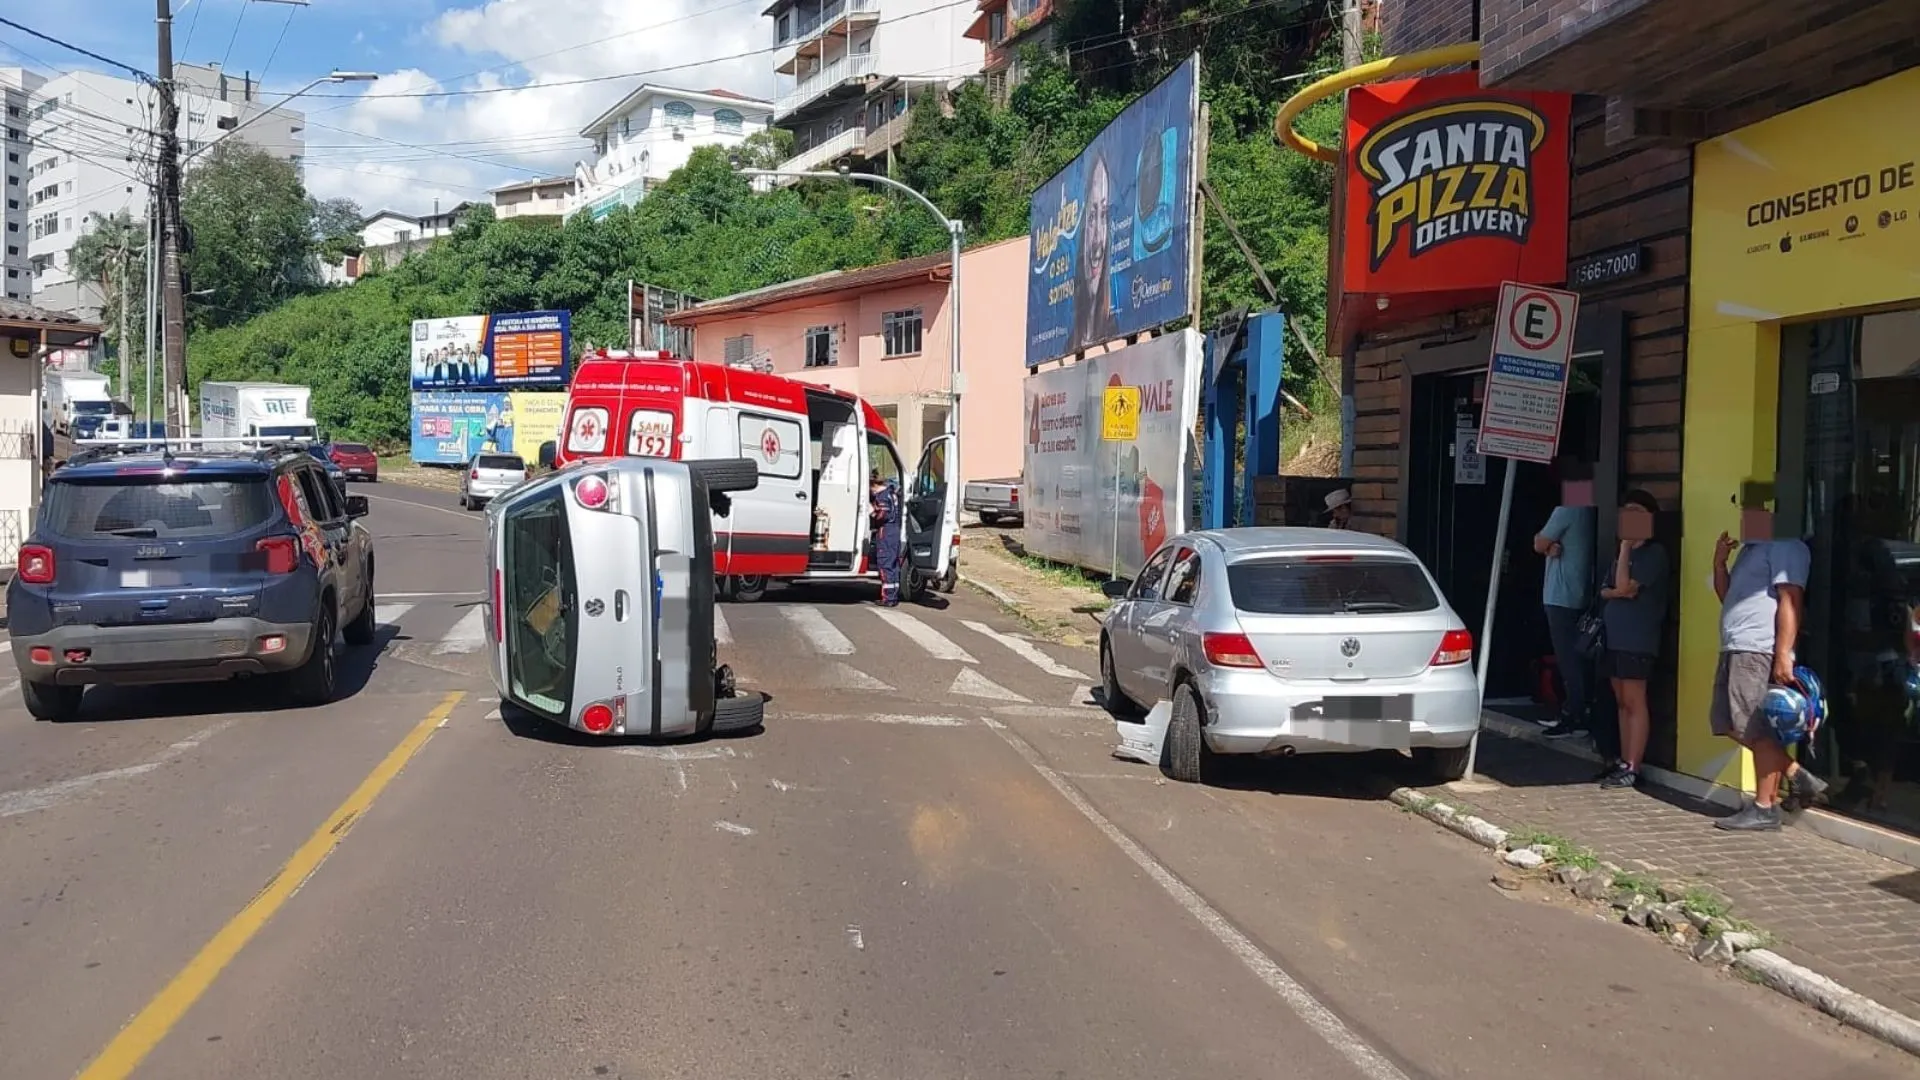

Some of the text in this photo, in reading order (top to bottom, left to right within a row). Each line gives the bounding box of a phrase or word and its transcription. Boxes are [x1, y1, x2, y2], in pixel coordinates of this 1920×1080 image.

[1377, 123, 1526, 197] SANTA
[1746, 161, 1915, 228] CONSERTO DE
[1376, 164, 1528, 259] PIZZA
[1893, 210, 1908, 222] LG
[1415, 208, 1528, 251] DELIVERY
[1524, 303, 1547, 340] E
[1498, 355, 1561, 373] ESTACIONAMENTO
[1502, 364, 1556, 379] ROTATIVO PAGO
[262, 397, 297, 415] RTE
[637, 419, 670, 434] SAMU
[1029, 393, 1040, 454] 4
[635, 434, 667, 457] 192
[137, 545, 167, 557] Jeep
